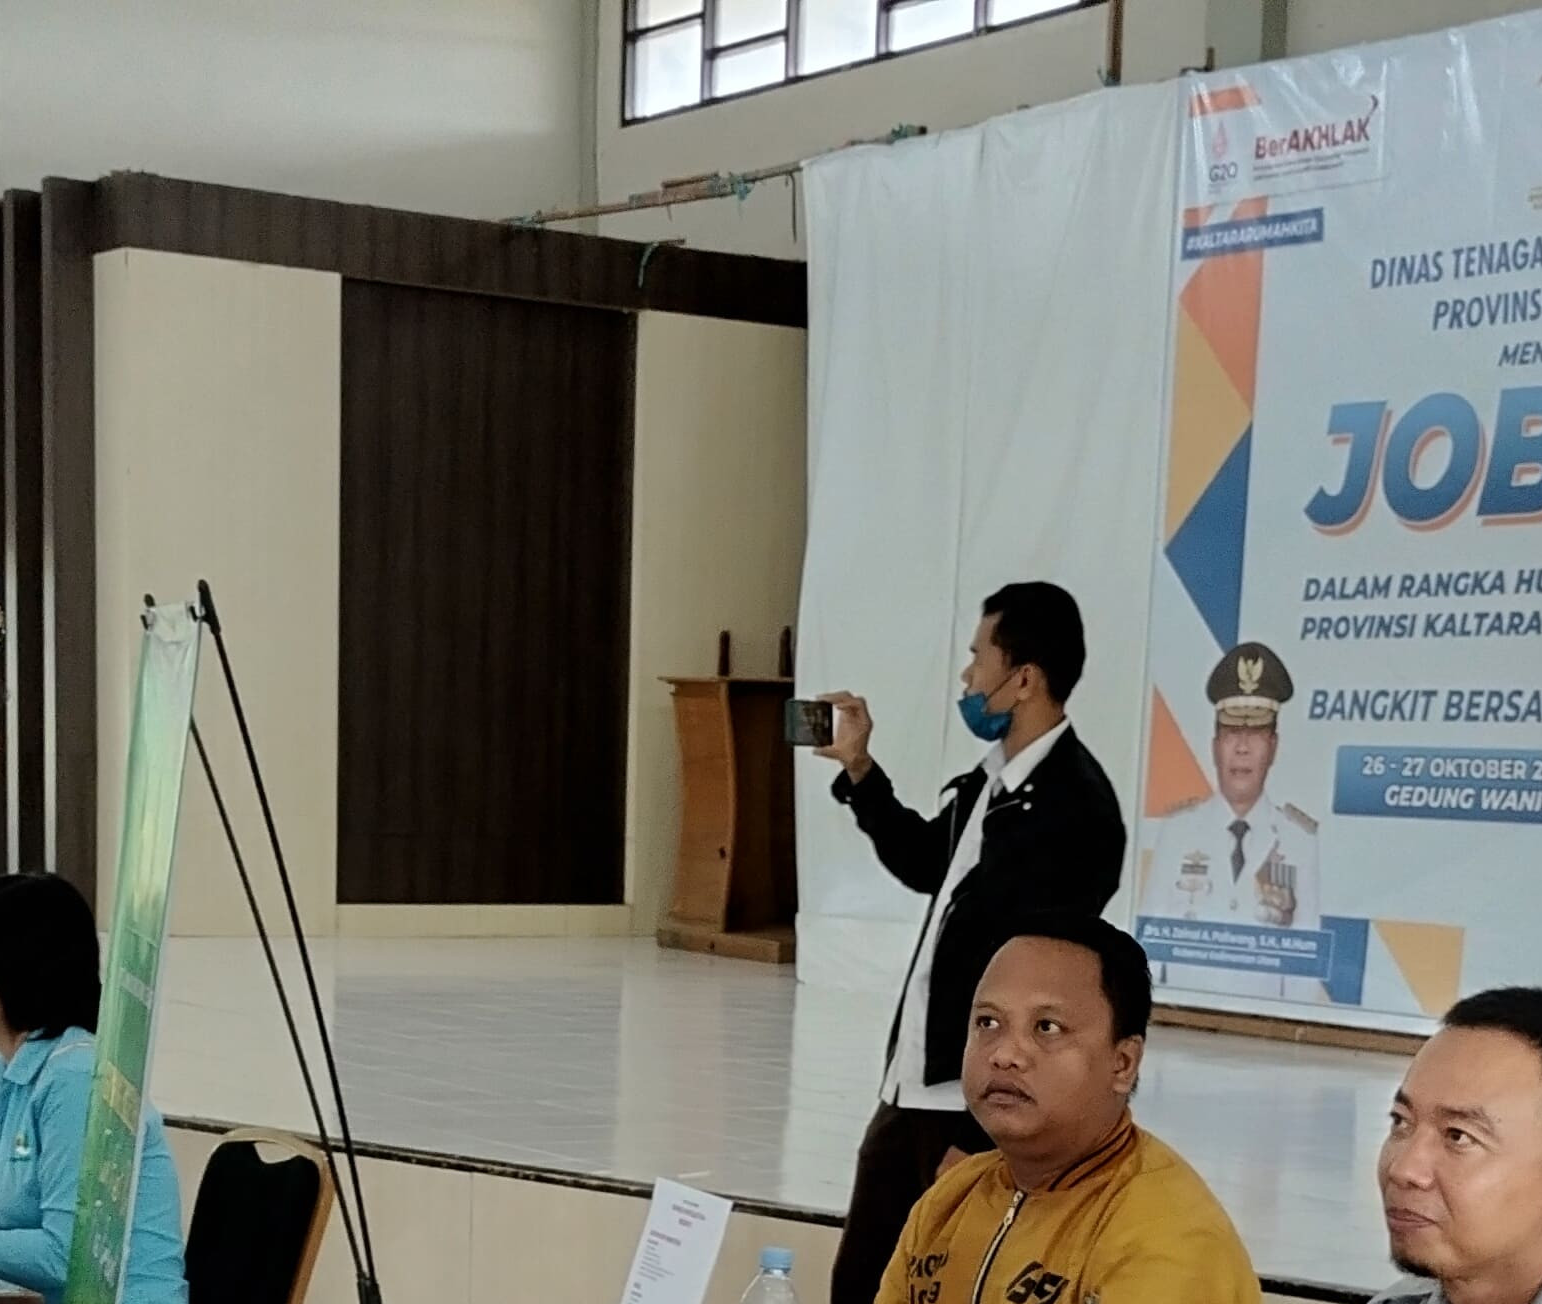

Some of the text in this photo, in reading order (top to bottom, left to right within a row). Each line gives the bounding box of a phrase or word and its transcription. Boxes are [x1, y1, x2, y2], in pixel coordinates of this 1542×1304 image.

[1255, 118, 1370, 159] BerAKHLAK
[1209, 162, 1237, 182] G20
[1370, 250, 1443, 289] DINAS
[1304, 576, 1391, 603] DALAM
[1397, 571, 1506, 600] RANGKA
[1301, 610, 1542, 641] PROVINSI KALTARA
[1308, 689, 1437, 721] BANGKIT
[1362, 756, 1385, 776] 26
[1400, 757, 1425, 777] 27
[1429, 757, 1527, 780] OKTOBER
[1384, 784, 1474, 810] GEDUNG
